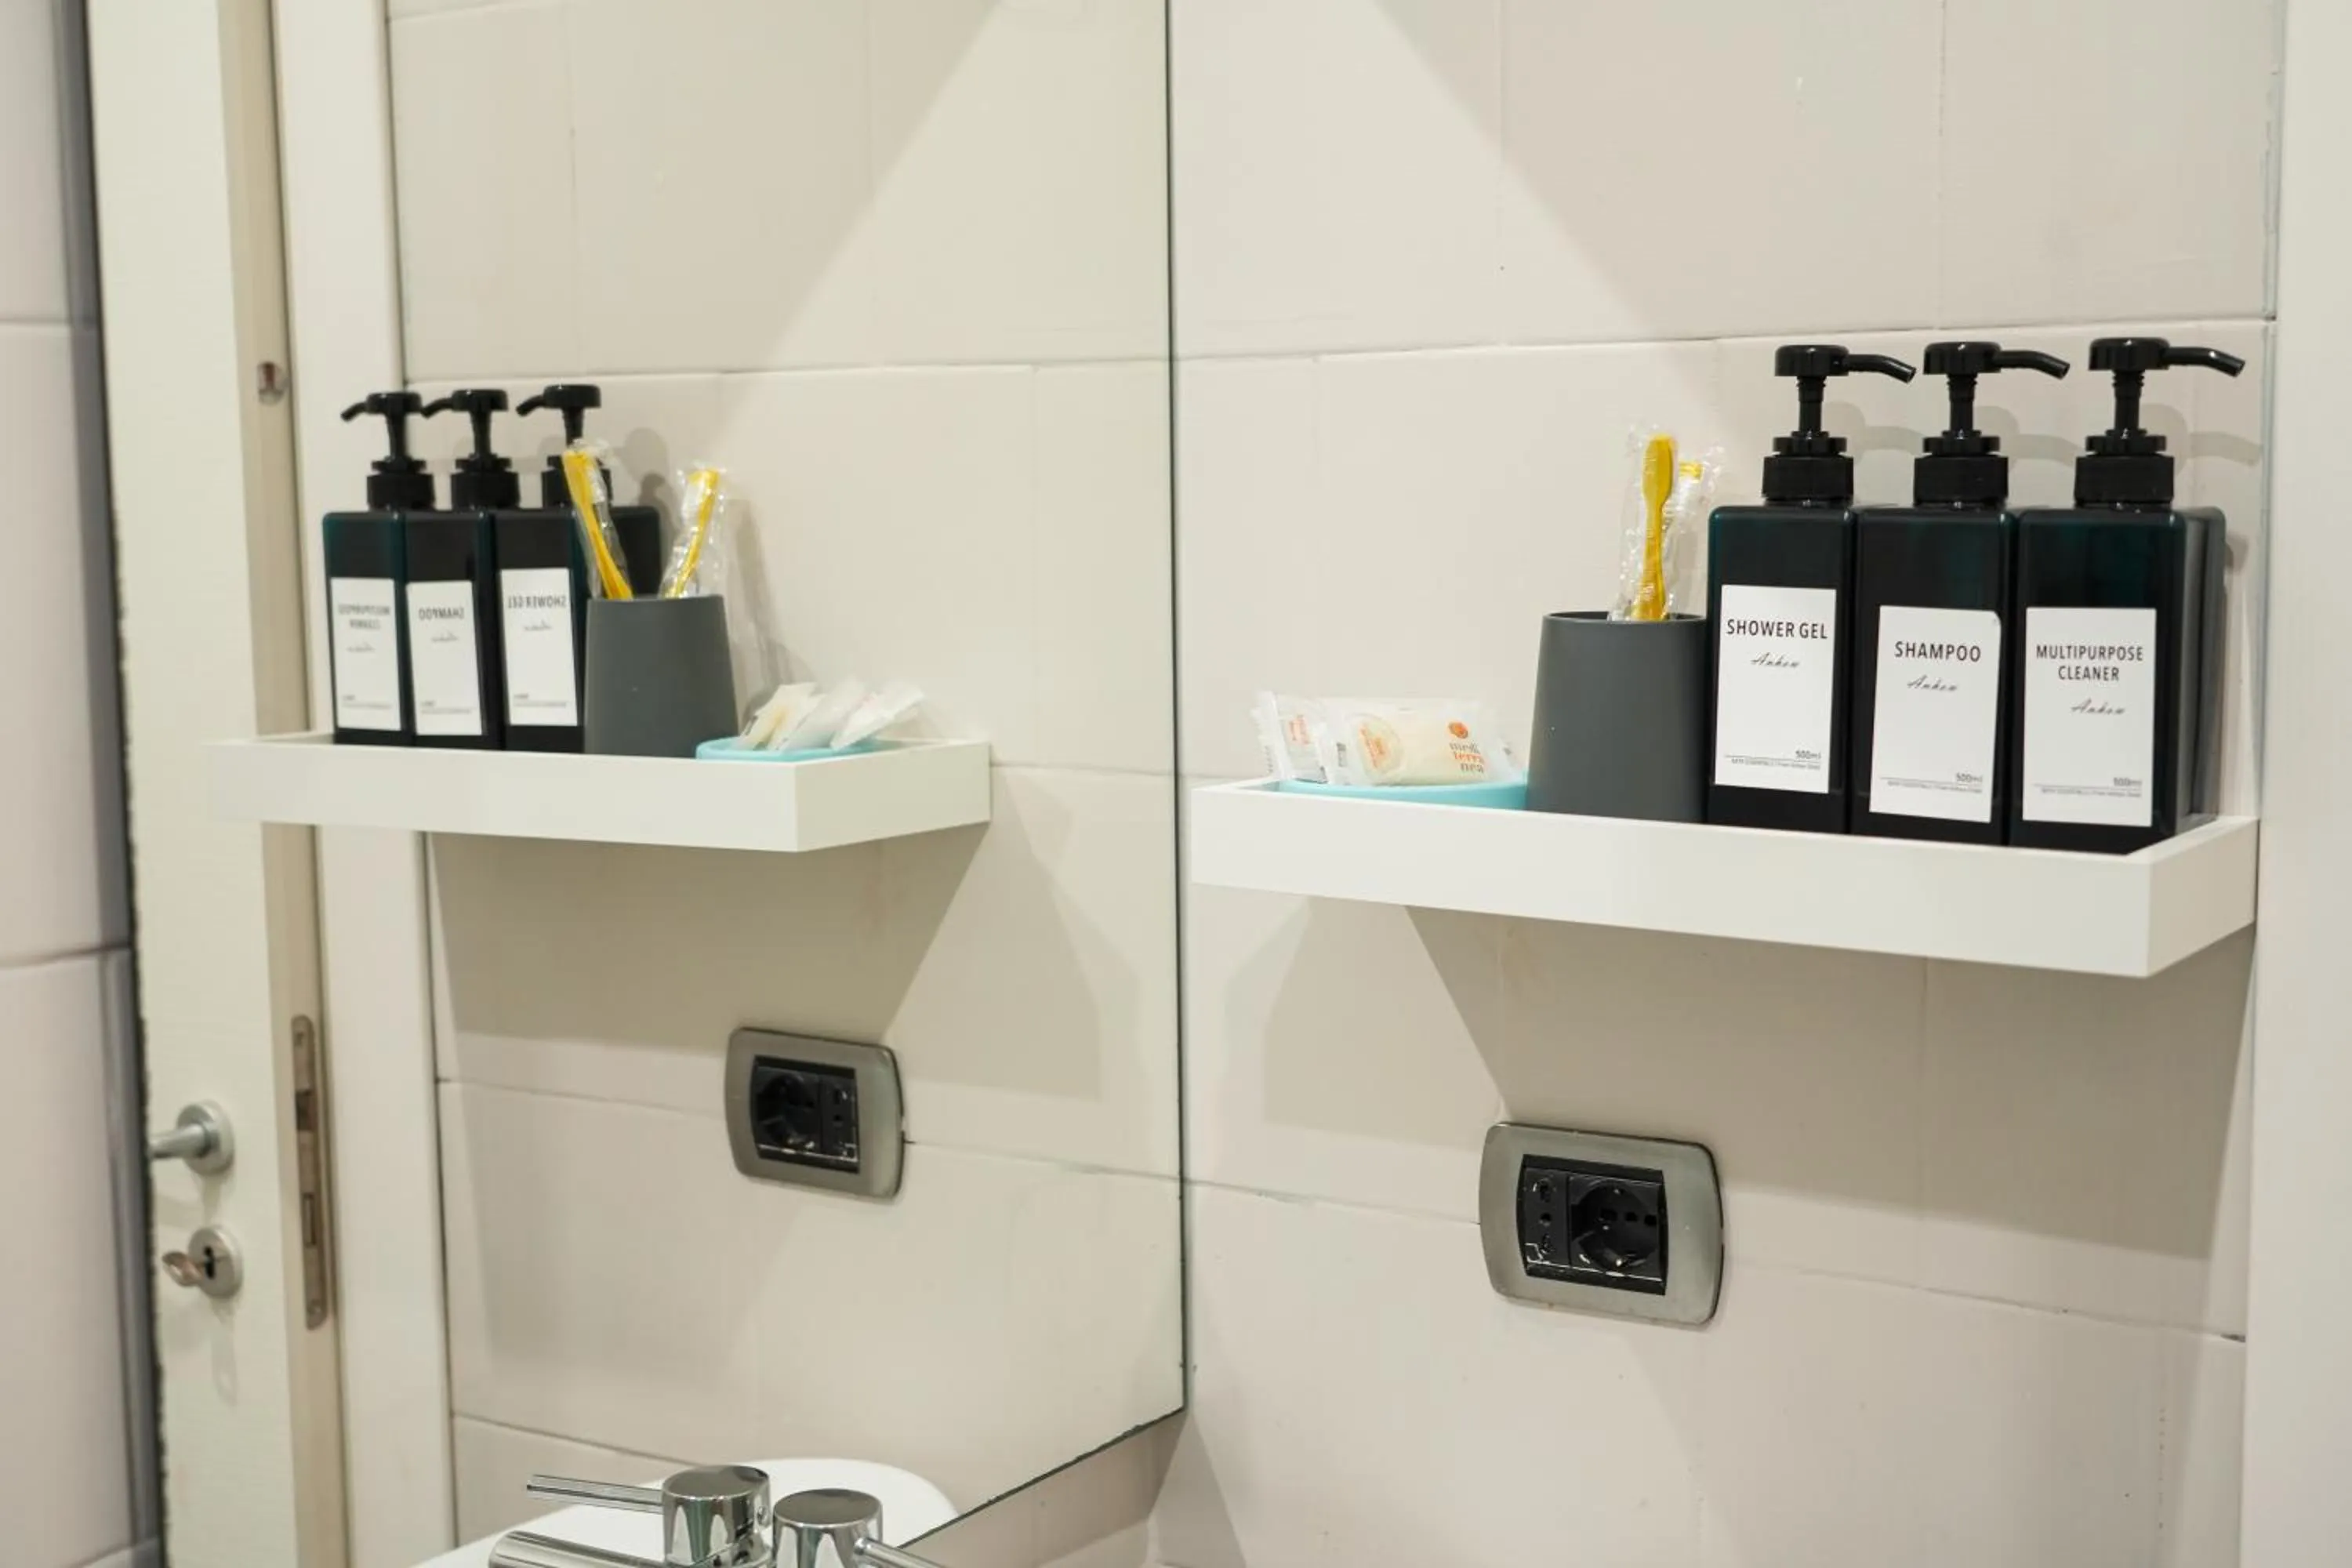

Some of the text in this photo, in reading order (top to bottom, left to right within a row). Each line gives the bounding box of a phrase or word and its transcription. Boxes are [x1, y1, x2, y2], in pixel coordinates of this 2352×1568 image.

[1727, 619, 1828, 639] SHOWER GEL
[1894, 641, 1981, 662] SHAMPOO
[2037, 644, 2143, 661] MULTIPURPOSE
[2058, 666, 2120, 681] CLEANER
